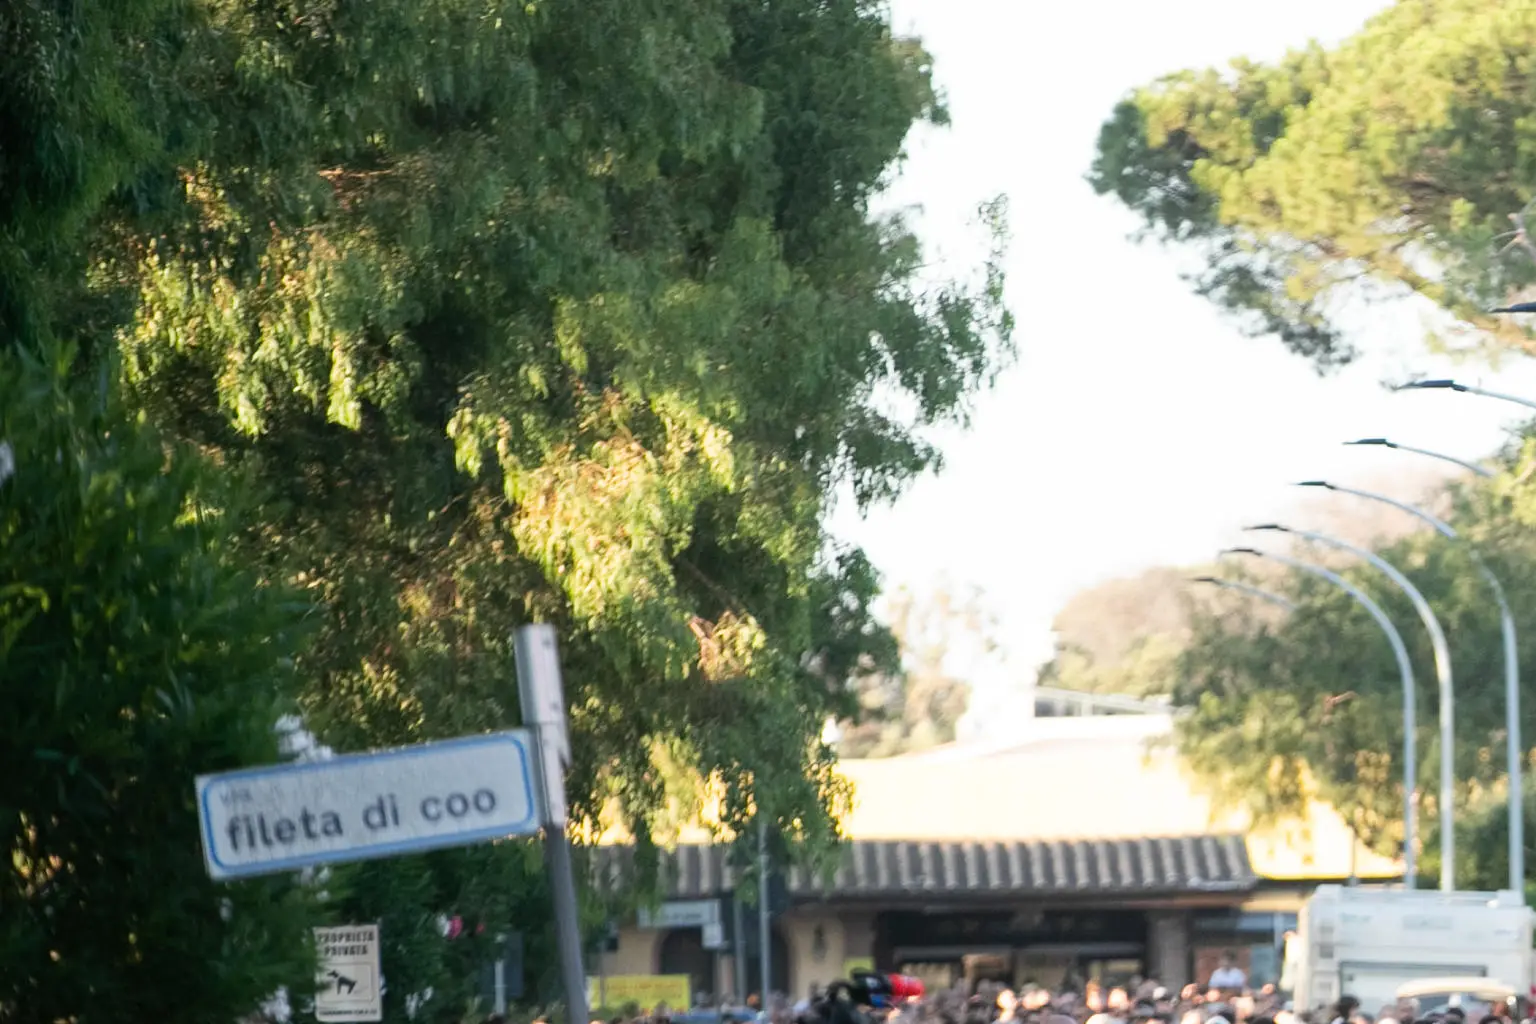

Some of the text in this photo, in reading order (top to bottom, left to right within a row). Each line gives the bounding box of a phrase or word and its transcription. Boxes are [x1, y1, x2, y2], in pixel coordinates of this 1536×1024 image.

[226, 788, 496, 852] fileta di coo
